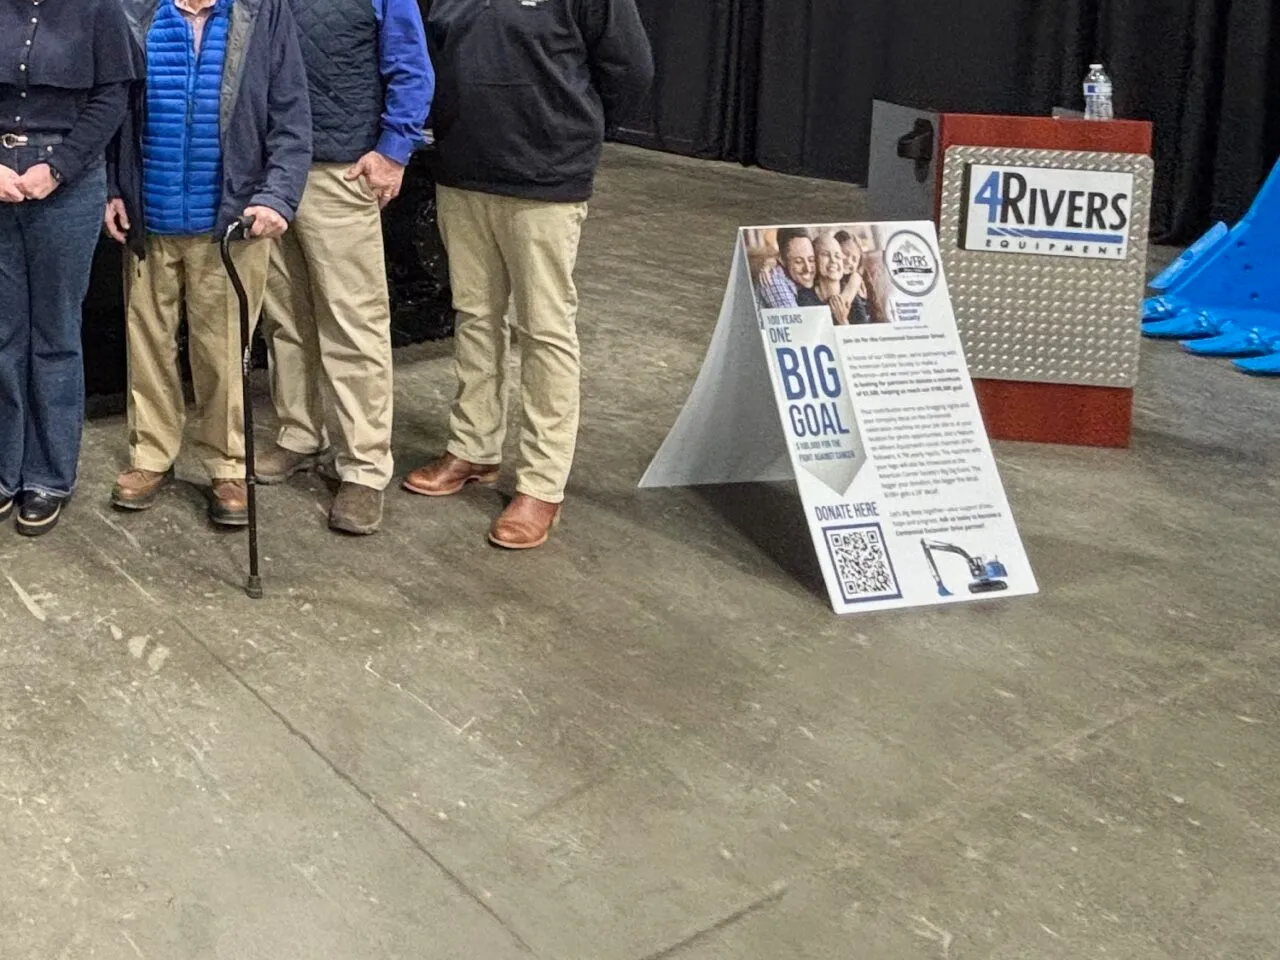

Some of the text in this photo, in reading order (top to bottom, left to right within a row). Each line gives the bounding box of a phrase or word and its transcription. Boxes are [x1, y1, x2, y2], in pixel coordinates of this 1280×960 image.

[974, 170, 1128, 231] 4RIVERS
[985, 239, 1123, 256] EQUIPMENT
[780, 313, 803, 325] YEARS
[769, 326, 793, 344] ONE
[775, 344, 842, 401] BIG
[789, 402, 850, 438] GOAL
[814, 503, 853, 522] DONATE
[853, 501, 880, 518] HERE
